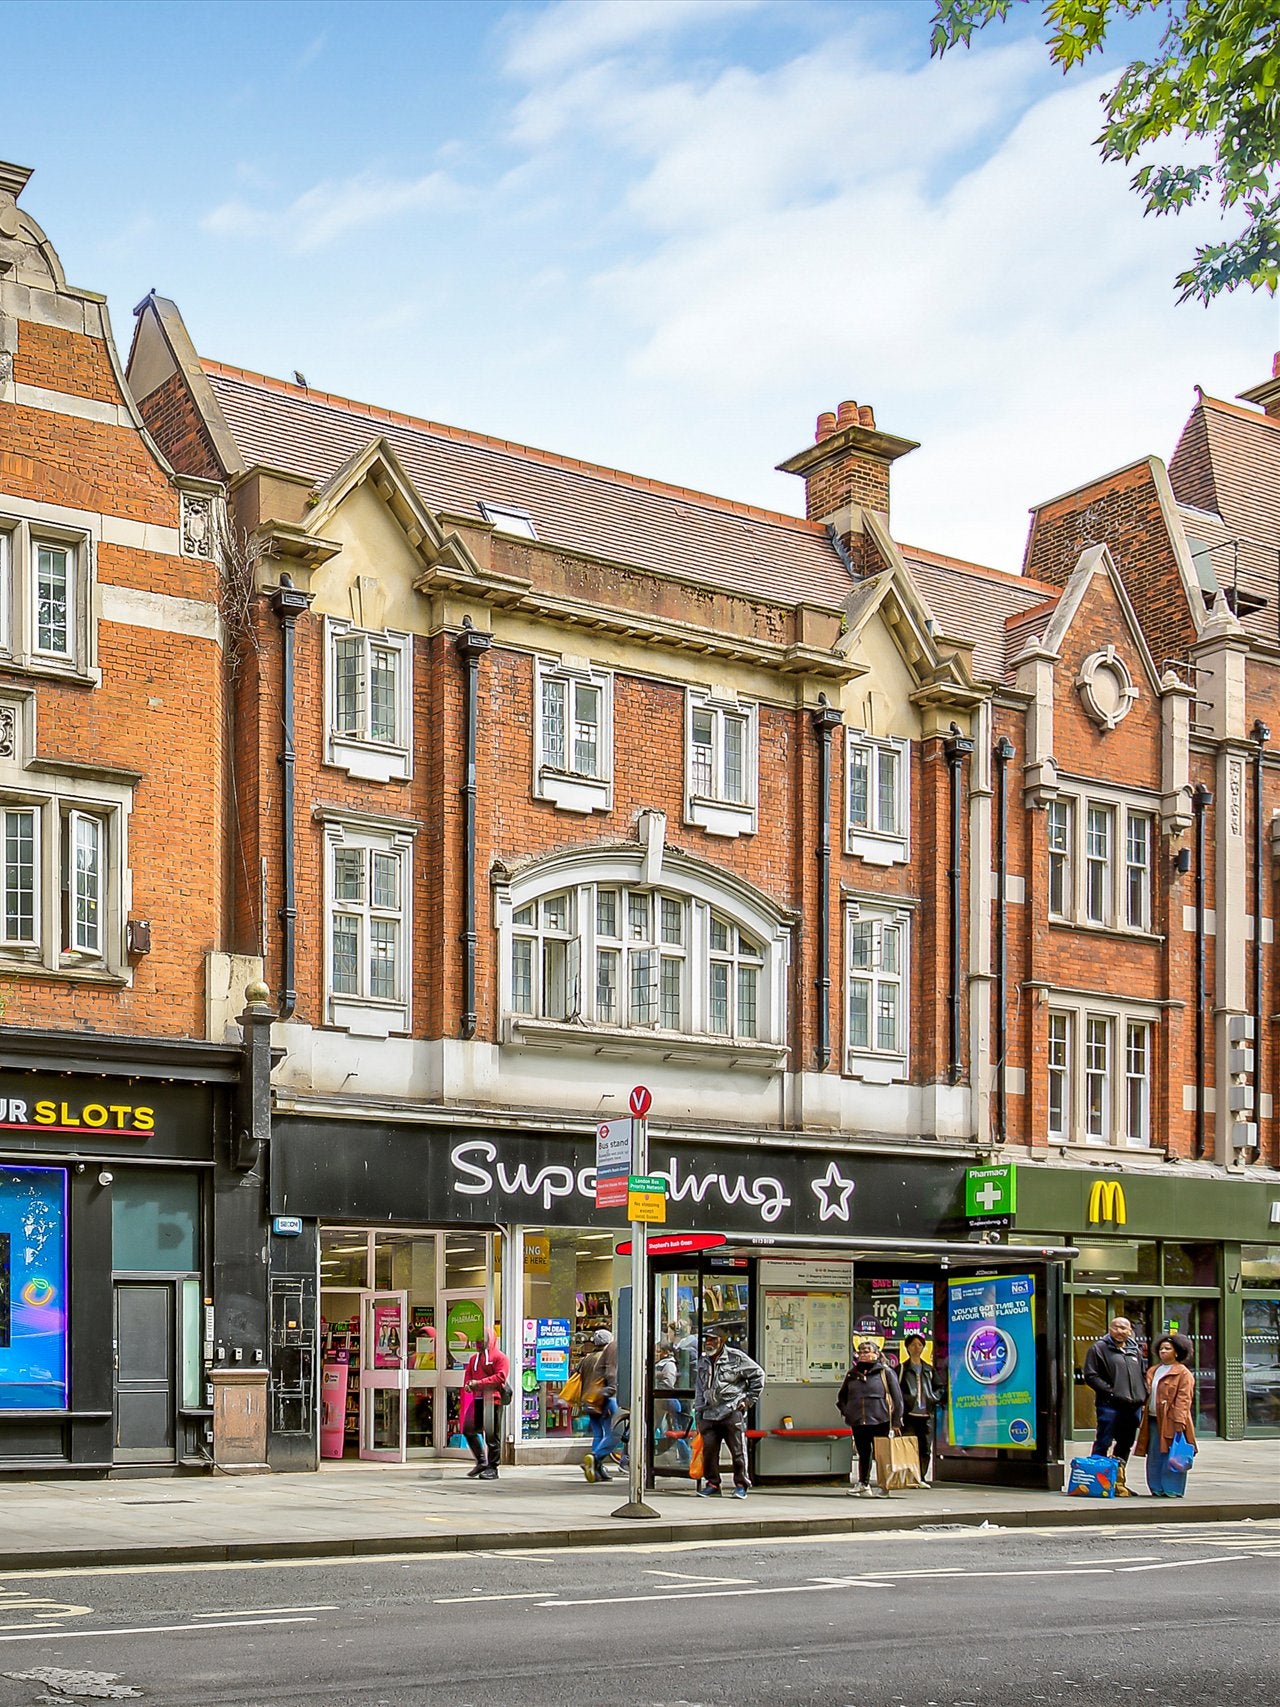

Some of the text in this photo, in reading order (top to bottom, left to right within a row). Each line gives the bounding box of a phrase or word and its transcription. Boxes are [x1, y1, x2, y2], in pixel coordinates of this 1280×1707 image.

[632, 1089, 646, 1110] V
[34, 1101, 155, 1129] SLOTS
[599, 1138, 629, 1150] Bus stand
[451, 1140, 792, 1222] Supedrug
[969, 1169, 1008, 1178] Pharmacy
[1012, 1284, 1028, 1292] No.1
[873, 1301, 900, 1317] fre
[951, 1306, 1029, 1321] SAVOUR THE FLAVOUR
[953, 1306, 978, 1315] YOU'VE
